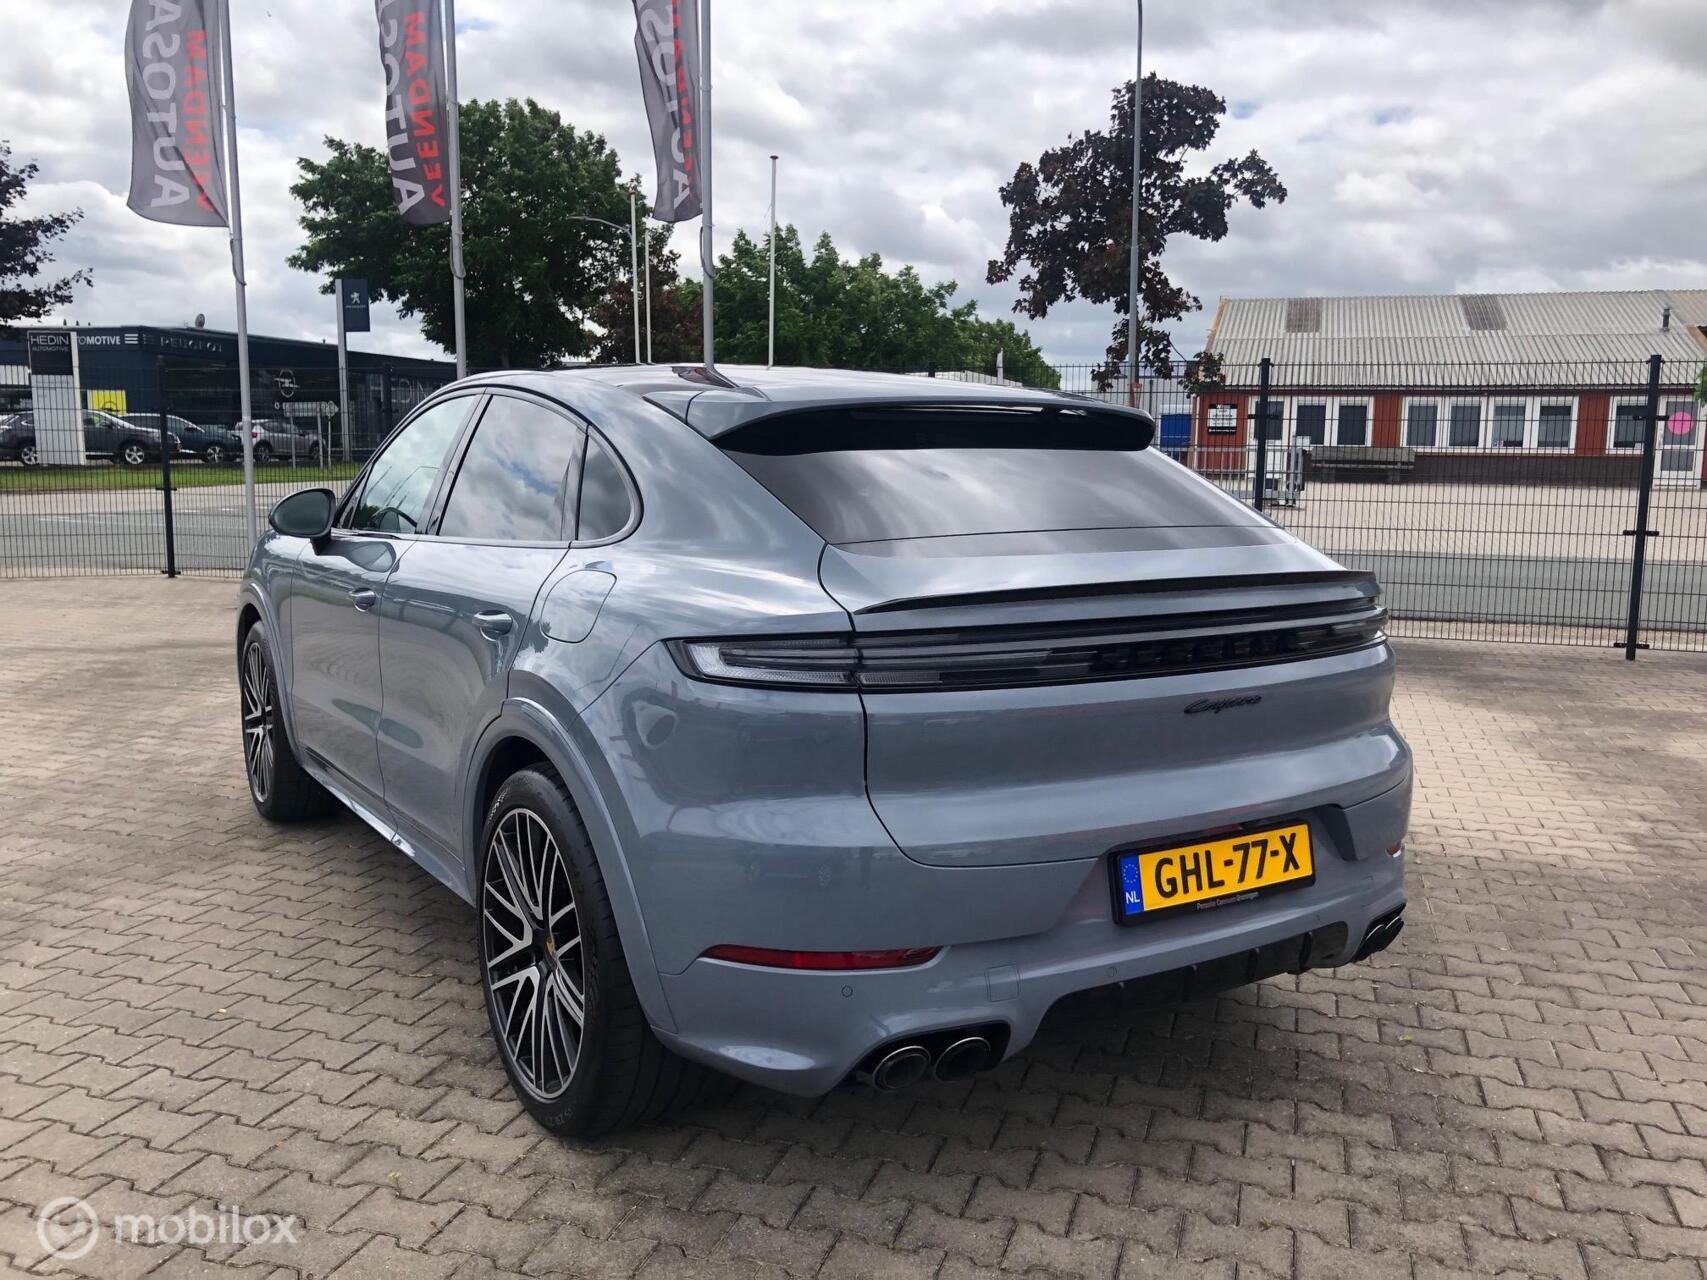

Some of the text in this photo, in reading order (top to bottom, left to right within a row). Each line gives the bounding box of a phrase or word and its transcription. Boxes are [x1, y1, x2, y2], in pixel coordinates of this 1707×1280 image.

[30, 335, 70, 345] HEDIN
[1154, 832, 1300, 899] GHL-77-X
[1125, 891, 1141, 905] NL
